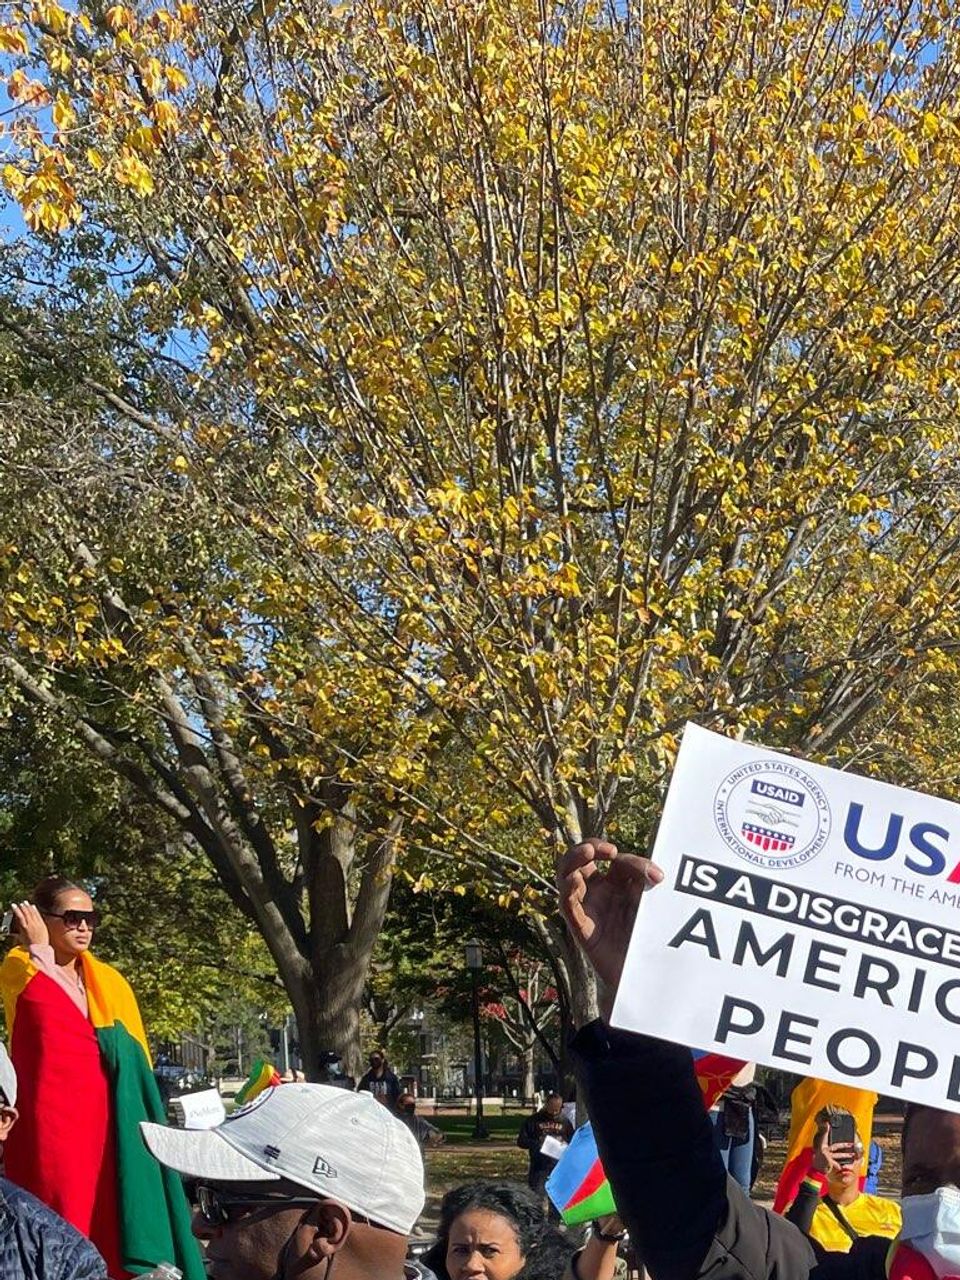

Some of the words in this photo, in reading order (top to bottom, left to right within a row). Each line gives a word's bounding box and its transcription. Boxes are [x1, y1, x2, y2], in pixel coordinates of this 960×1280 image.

[727, 764, 762, 785] UNITED
[764, 762, 800, 778] STATES
[800, 775, 828, 812] AGENCY
[756, 783, 800, 803] USAID
[717, 799, 766, 866] INTERNATIONAL
[768, 829, 828, 867] DEVELOPMENT
[680, 860, 719, 893] IS
[725, 875, 756, 906] A
[834, 861, 885, 888] FROM
[891, 875, 925, 899] THE
